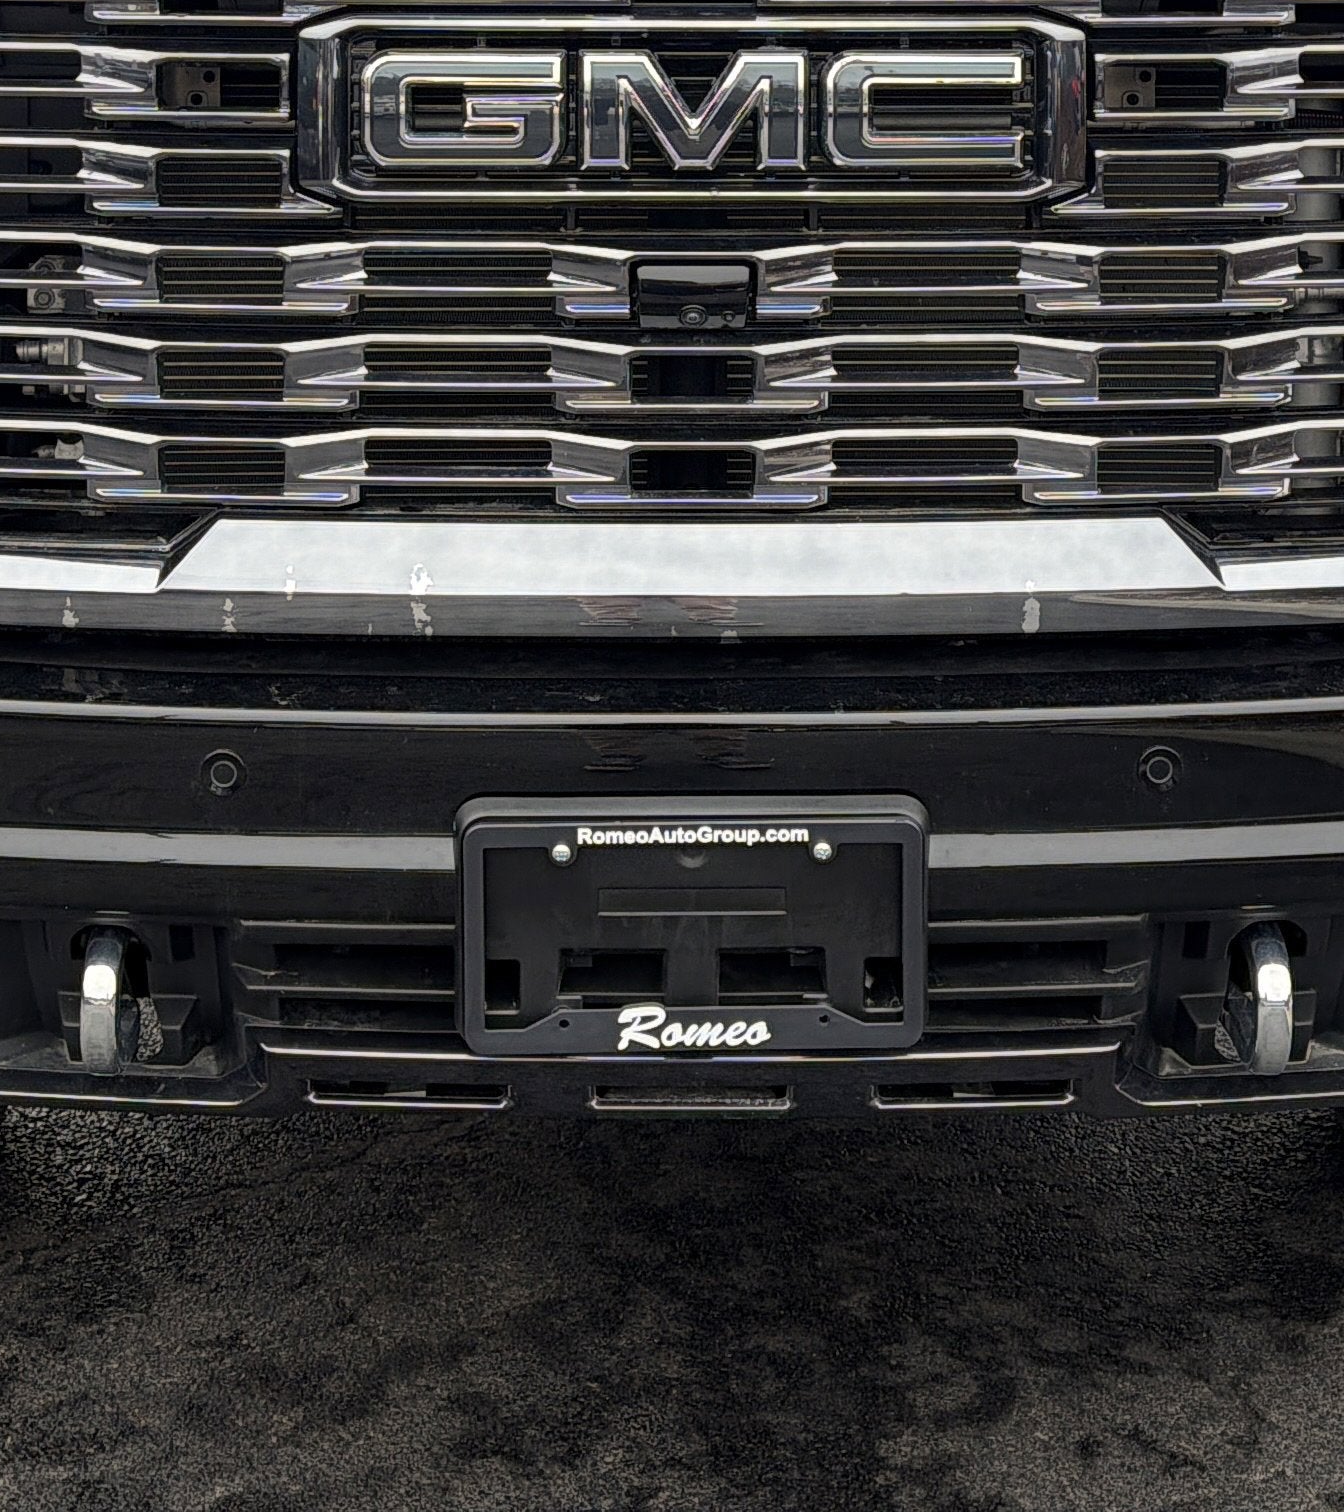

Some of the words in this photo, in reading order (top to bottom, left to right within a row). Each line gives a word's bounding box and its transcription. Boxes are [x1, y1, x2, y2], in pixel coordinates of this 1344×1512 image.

[361, 48, 1025, 171] GMC
[576, 826, 810, 848] RomeoAutoGroup.com
[616, 1005, 772, 1051] Romeo
